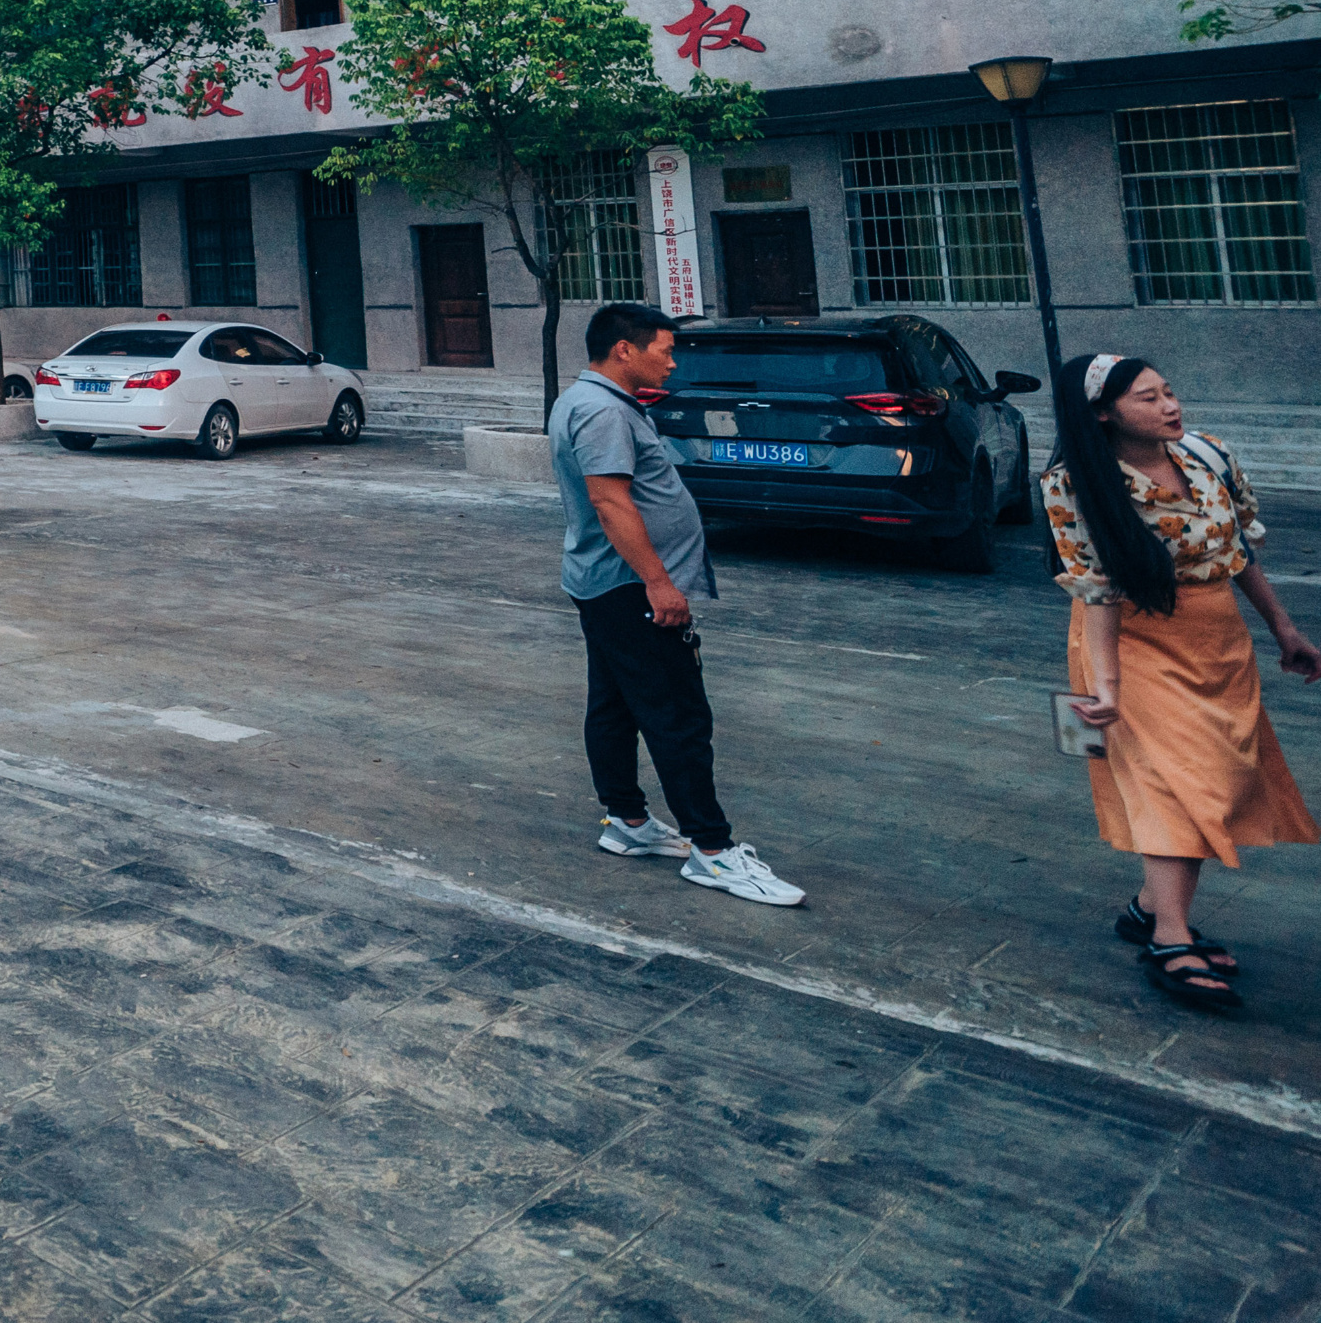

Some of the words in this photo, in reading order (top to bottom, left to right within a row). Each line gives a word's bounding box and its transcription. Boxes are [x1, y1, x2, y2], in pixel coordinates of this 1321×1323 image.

[661, 179, 683, 315] 上饶市广信区新时代文明实践中
